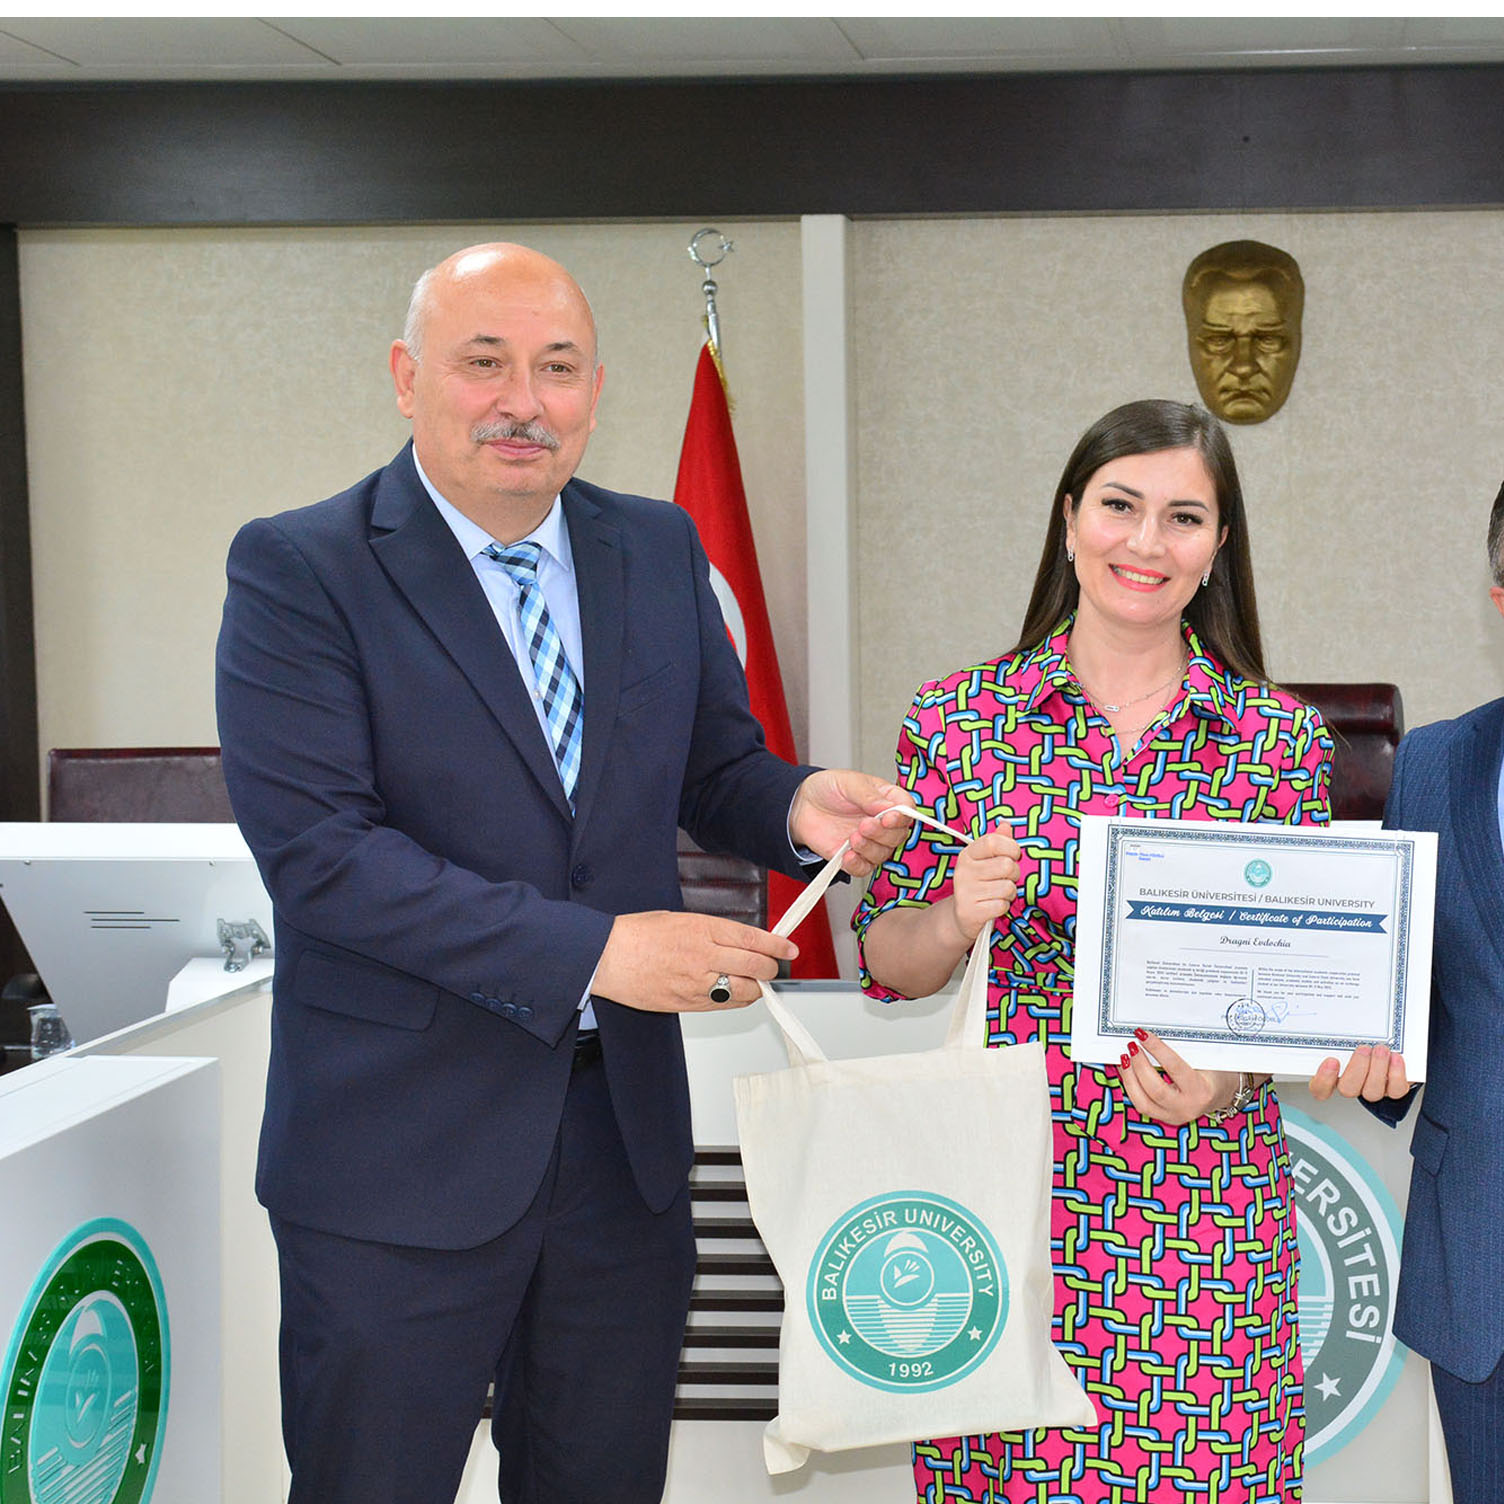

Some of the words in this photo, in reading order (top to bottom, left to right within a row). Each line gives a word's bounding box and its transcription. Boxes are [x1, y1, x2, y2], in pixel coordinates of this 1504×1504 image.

[1318, 898, 1376, 909] UNIVERSITY
[1183, 907, 1225, 922] Belgesi
[1239, 911, 1289, 925] Certificate
[1292, 914, 1304, 926] of
[1305, 914, 1373, 929] Participation
[821, 1209, 898, 1301] BALIKESİR
[904, 1208, 994, 1297] UNIVERSITY
[1289, 1151, 1382, 1344] ERSİTESİ
[888, 1360, 935, 1378] 1992
